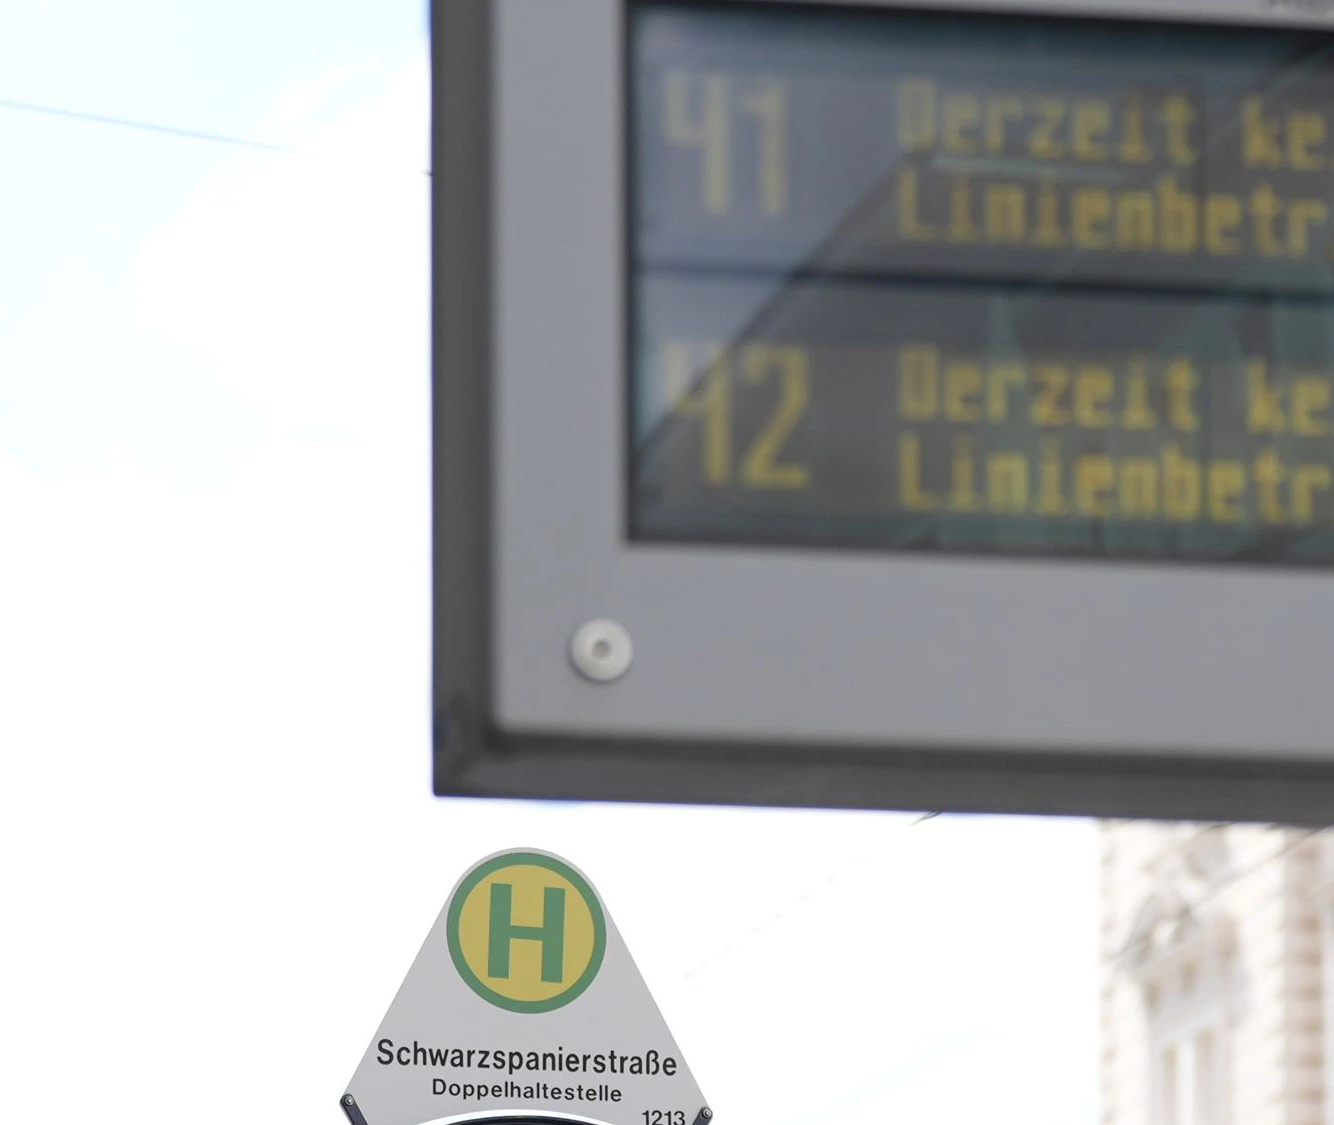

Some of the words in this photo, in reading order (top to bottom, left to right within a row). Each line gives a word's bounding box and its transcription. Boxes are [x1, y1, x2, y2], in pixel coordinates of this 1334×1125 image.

[663, 69, 787, 217] 41
[897, 75, 1198, 166] Derzeit
[664, 341, 810, 488] 42
[898, 343, 1199, 433] Derzeit
[487, 882, 566, 985] H
[376, 1038, 678, 1077] Schwarzspanierstraße
[432, 1078, 622, 1103] Doppelhaltestelle
